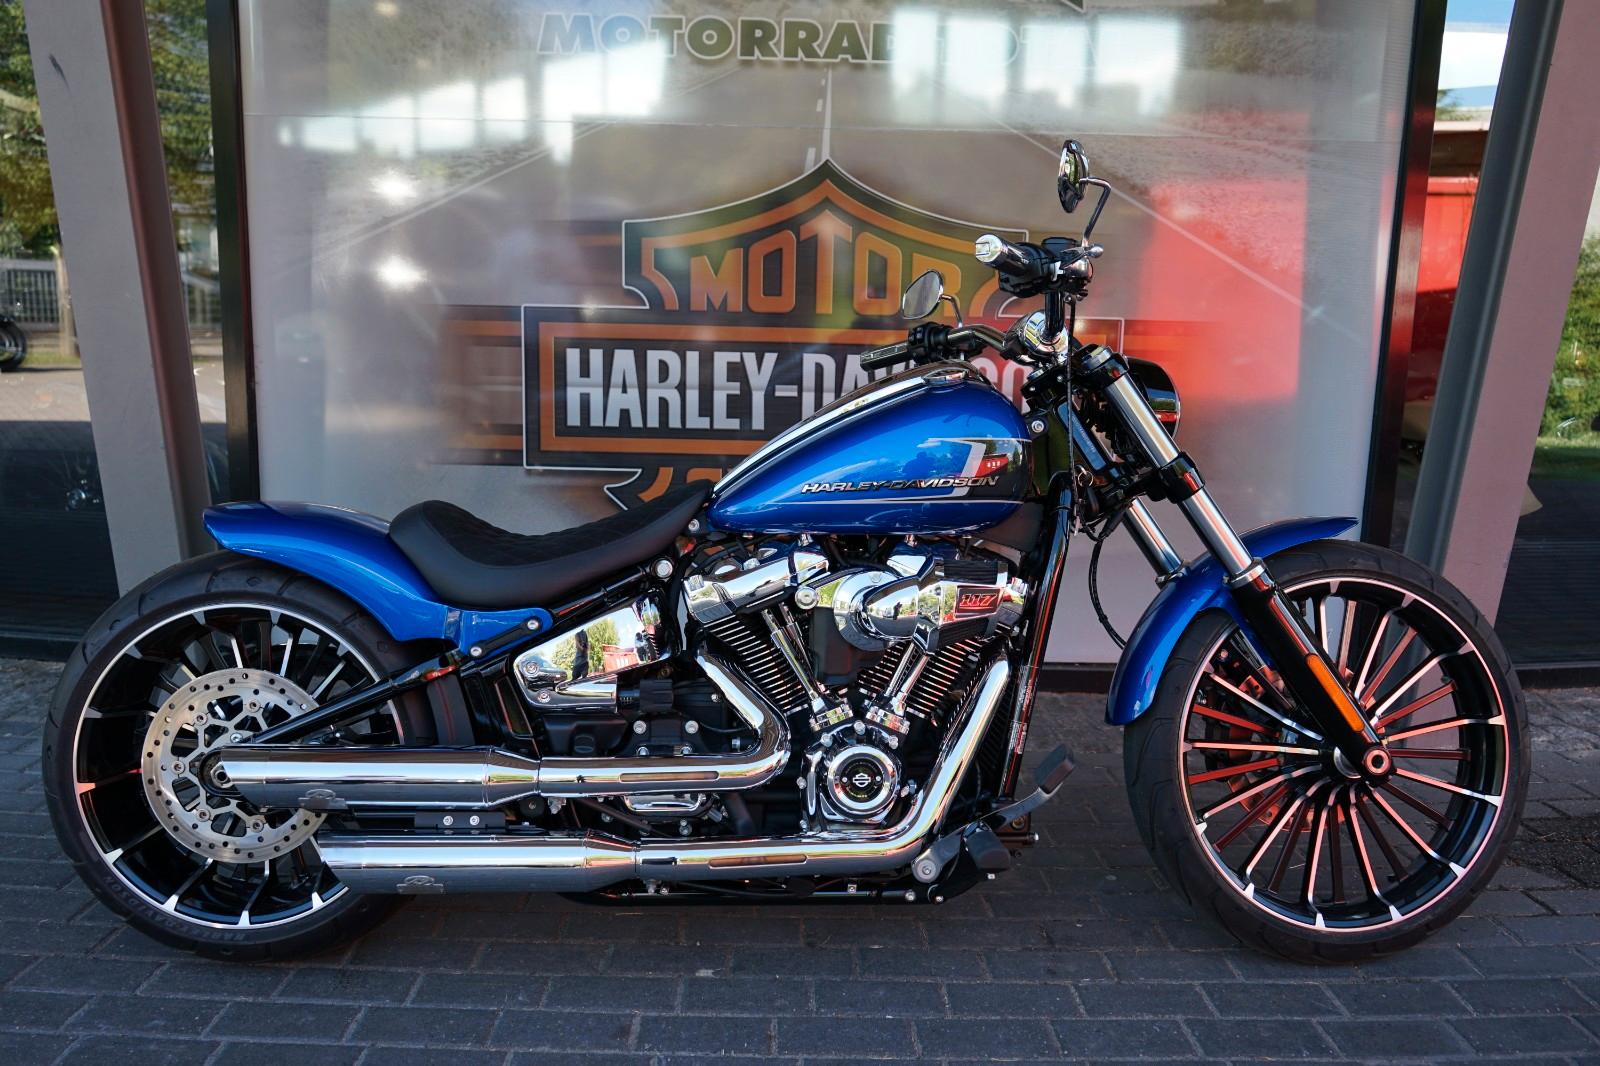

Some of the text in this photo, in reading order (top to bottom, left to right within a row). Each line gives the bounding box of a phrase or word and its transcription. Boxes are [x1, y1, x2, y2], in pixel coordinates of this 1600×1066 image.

[689, 209, 962, 316] MOTOR
[801, 476, 1000, 494] HARLEY-DAVIDSON
[960, 594, 998, 607] 117
